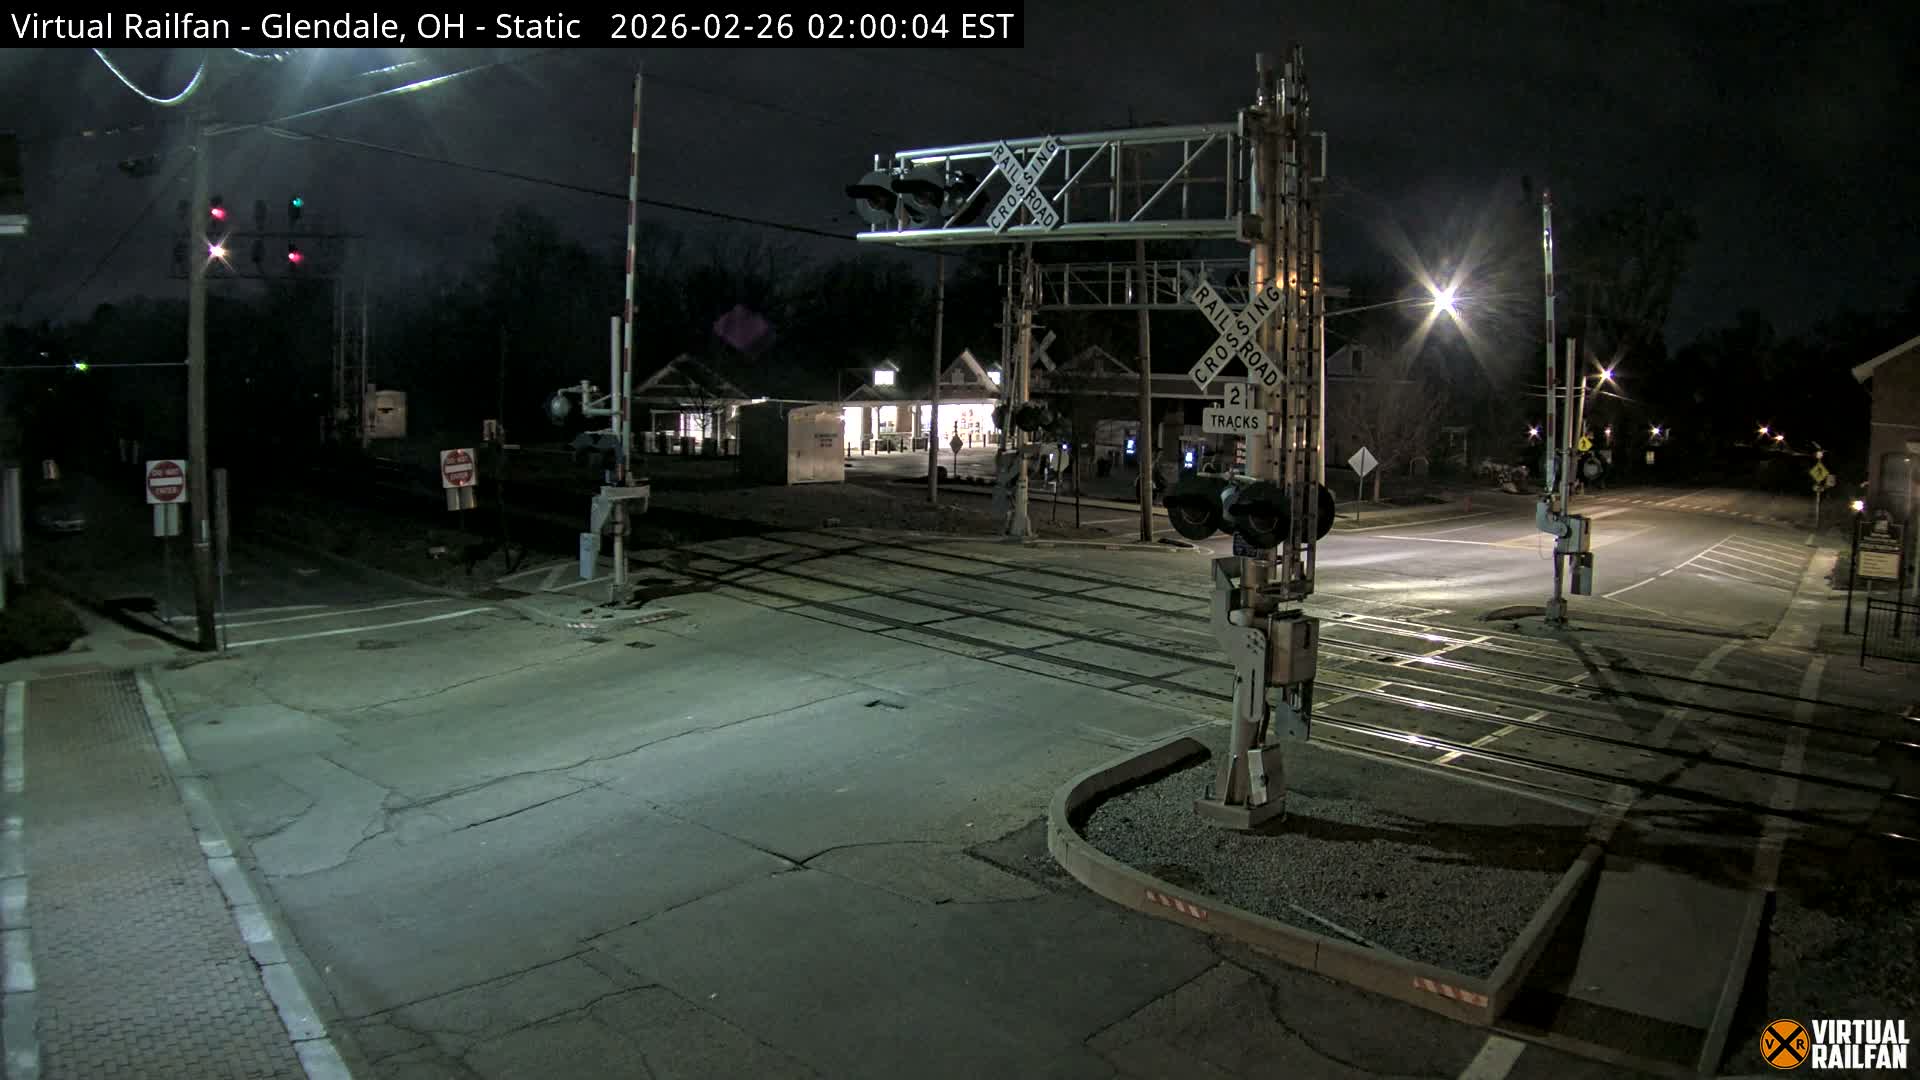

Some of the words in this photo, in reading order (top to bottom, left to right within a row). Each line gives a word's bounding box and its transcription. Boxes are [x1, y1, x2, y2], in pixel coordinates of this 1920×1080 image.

[991, 140, 1056, 229] CROSSING
[1195, 286, 1280, 383] CROSSING
[1211, 414, 1259, 429] TRACKS
[1230, 387, 1240, 405] 2
